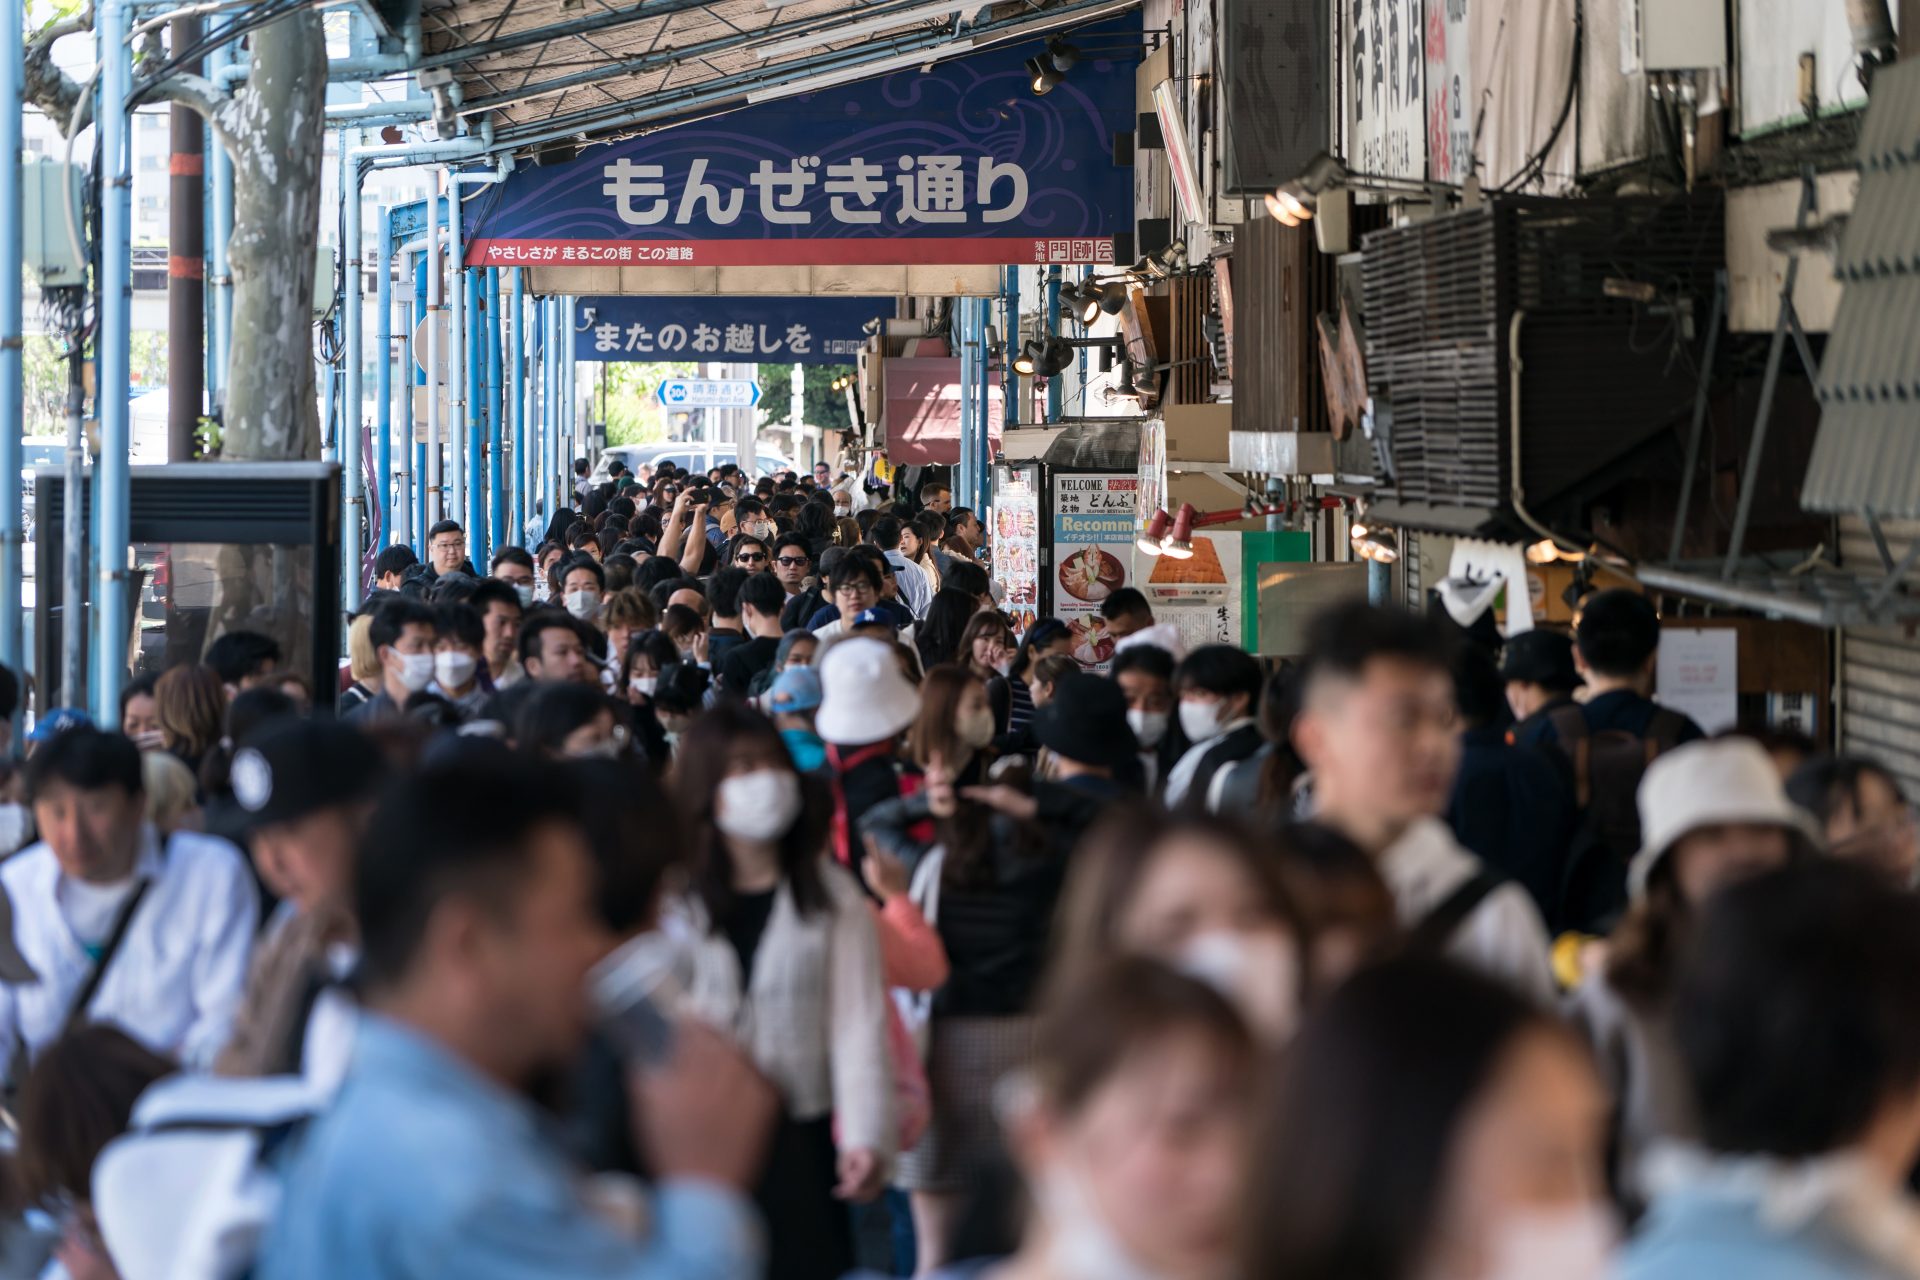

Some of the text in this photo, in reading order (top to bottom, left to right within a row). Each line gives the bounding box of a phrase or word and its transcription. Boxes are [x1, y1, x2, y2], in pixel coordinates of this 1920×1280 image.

[603, 155, 1029, 225] もんぜき通り
[488, 246, 693, 260] やさしさが 走るこの街 この道路
[1035, 241, 1045, 262] 築地
[1049, 240, 1112, 261] 門跡会
[594, 323, 811, 353] またのお越しを
[1061, 480, 1102, 490] WELCOME
[1061, 494, 1079, 502] 築地
[1061, 505, 1079, 513] 名物
[1062, 517, 1133, 531] Recomm
